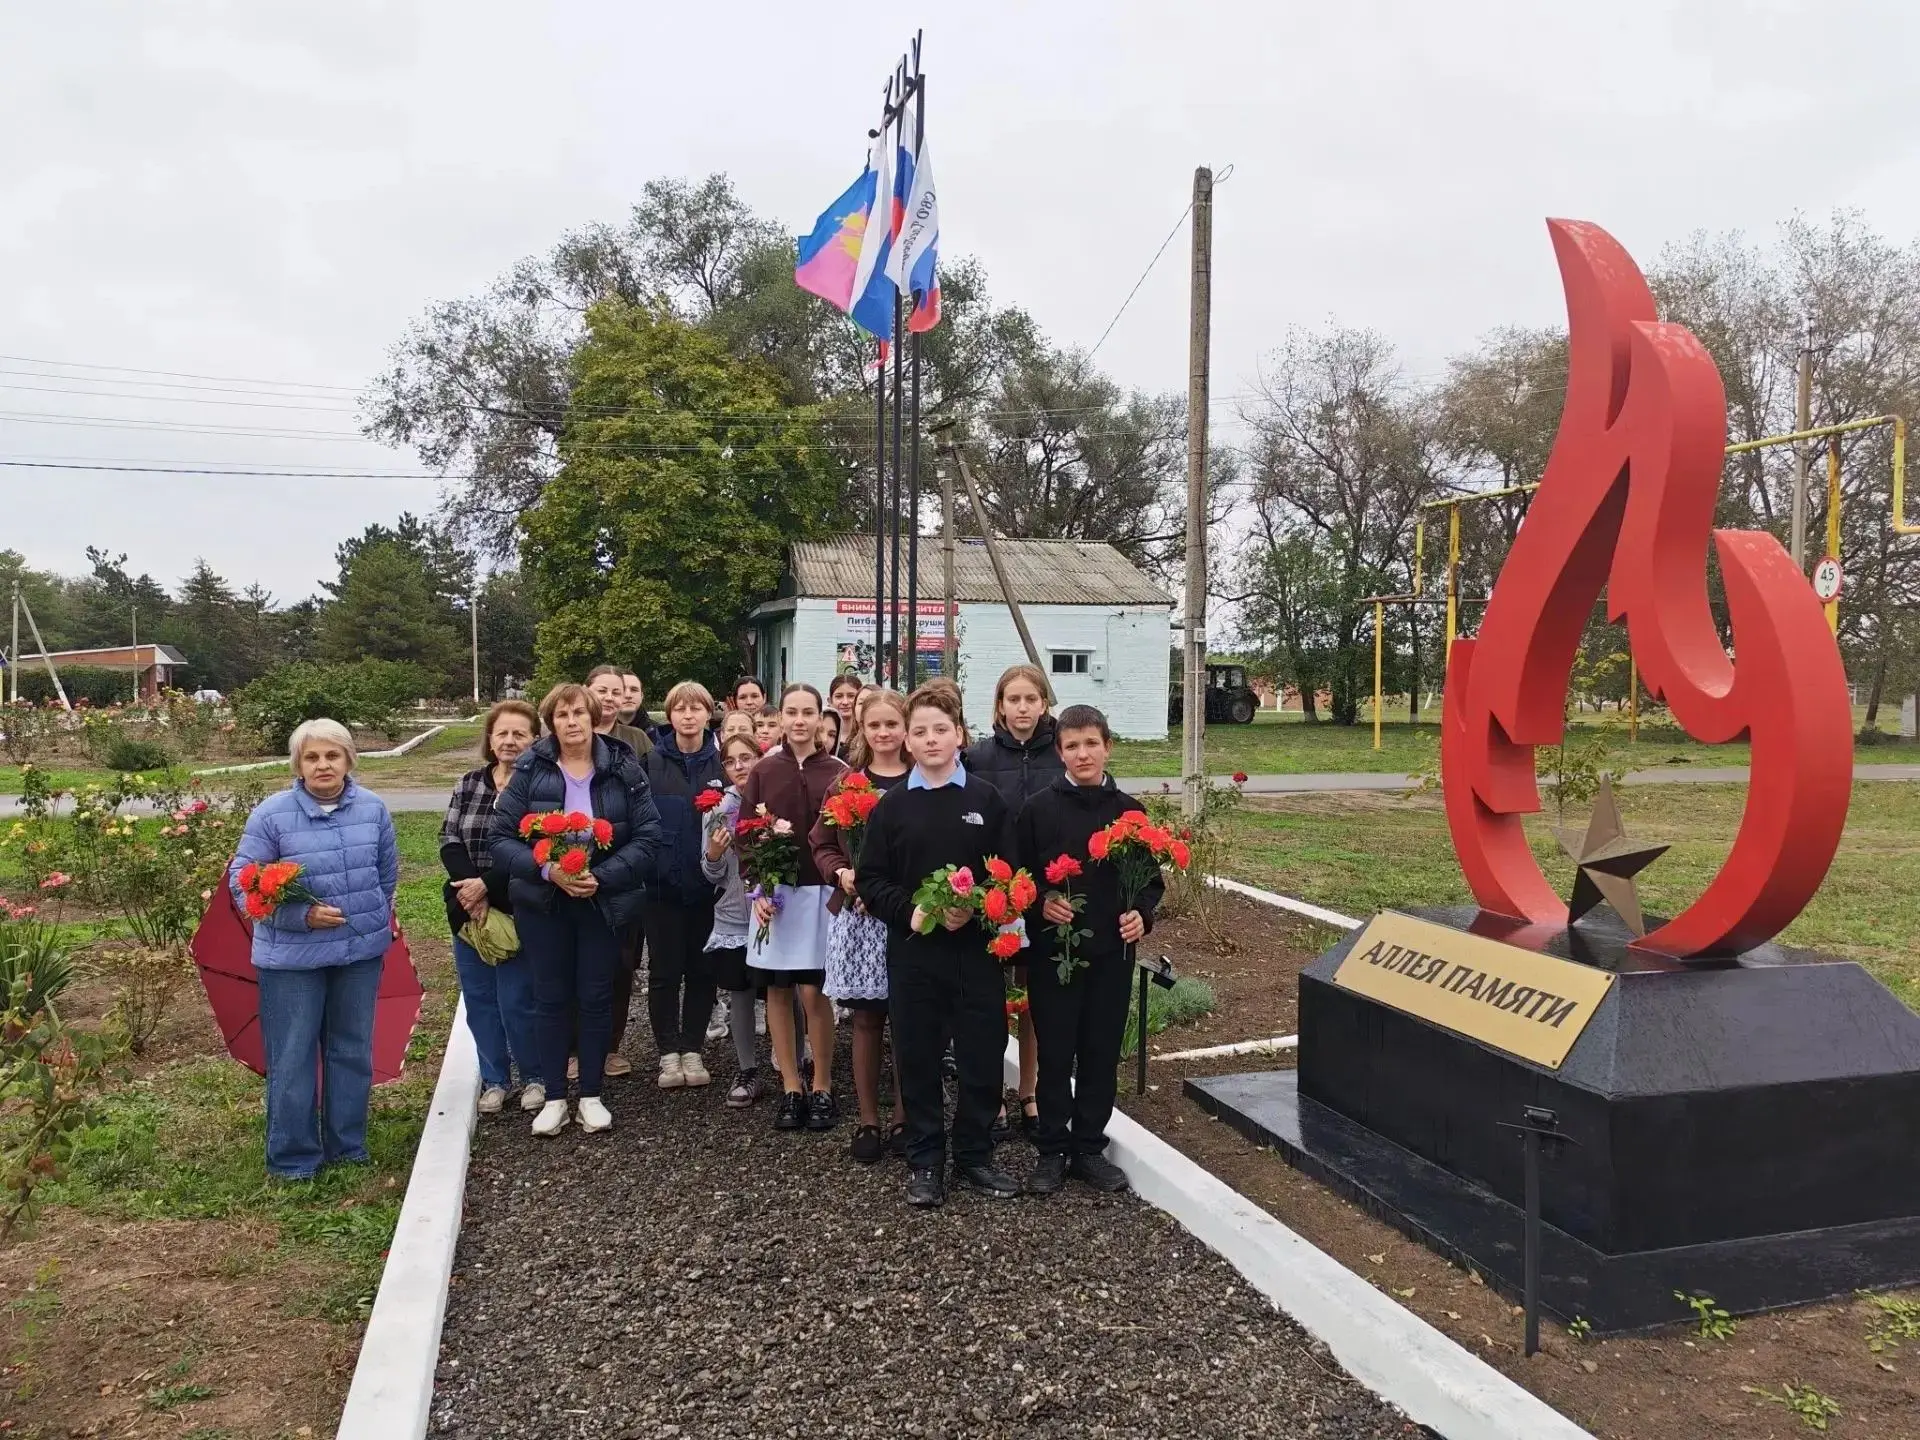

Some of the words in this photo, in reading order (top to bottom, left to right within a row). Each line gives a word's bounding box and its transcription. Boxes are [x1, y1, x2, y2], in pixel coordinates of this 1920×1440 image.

[841, 603, 897, 612] ВНИМАИ
[847, 617, 887, 626] Питбак
[1360, 940, 1446, 984] АЛЛЕЯ
[1440, 964, 1578, 1028] ПАМЯТИ
